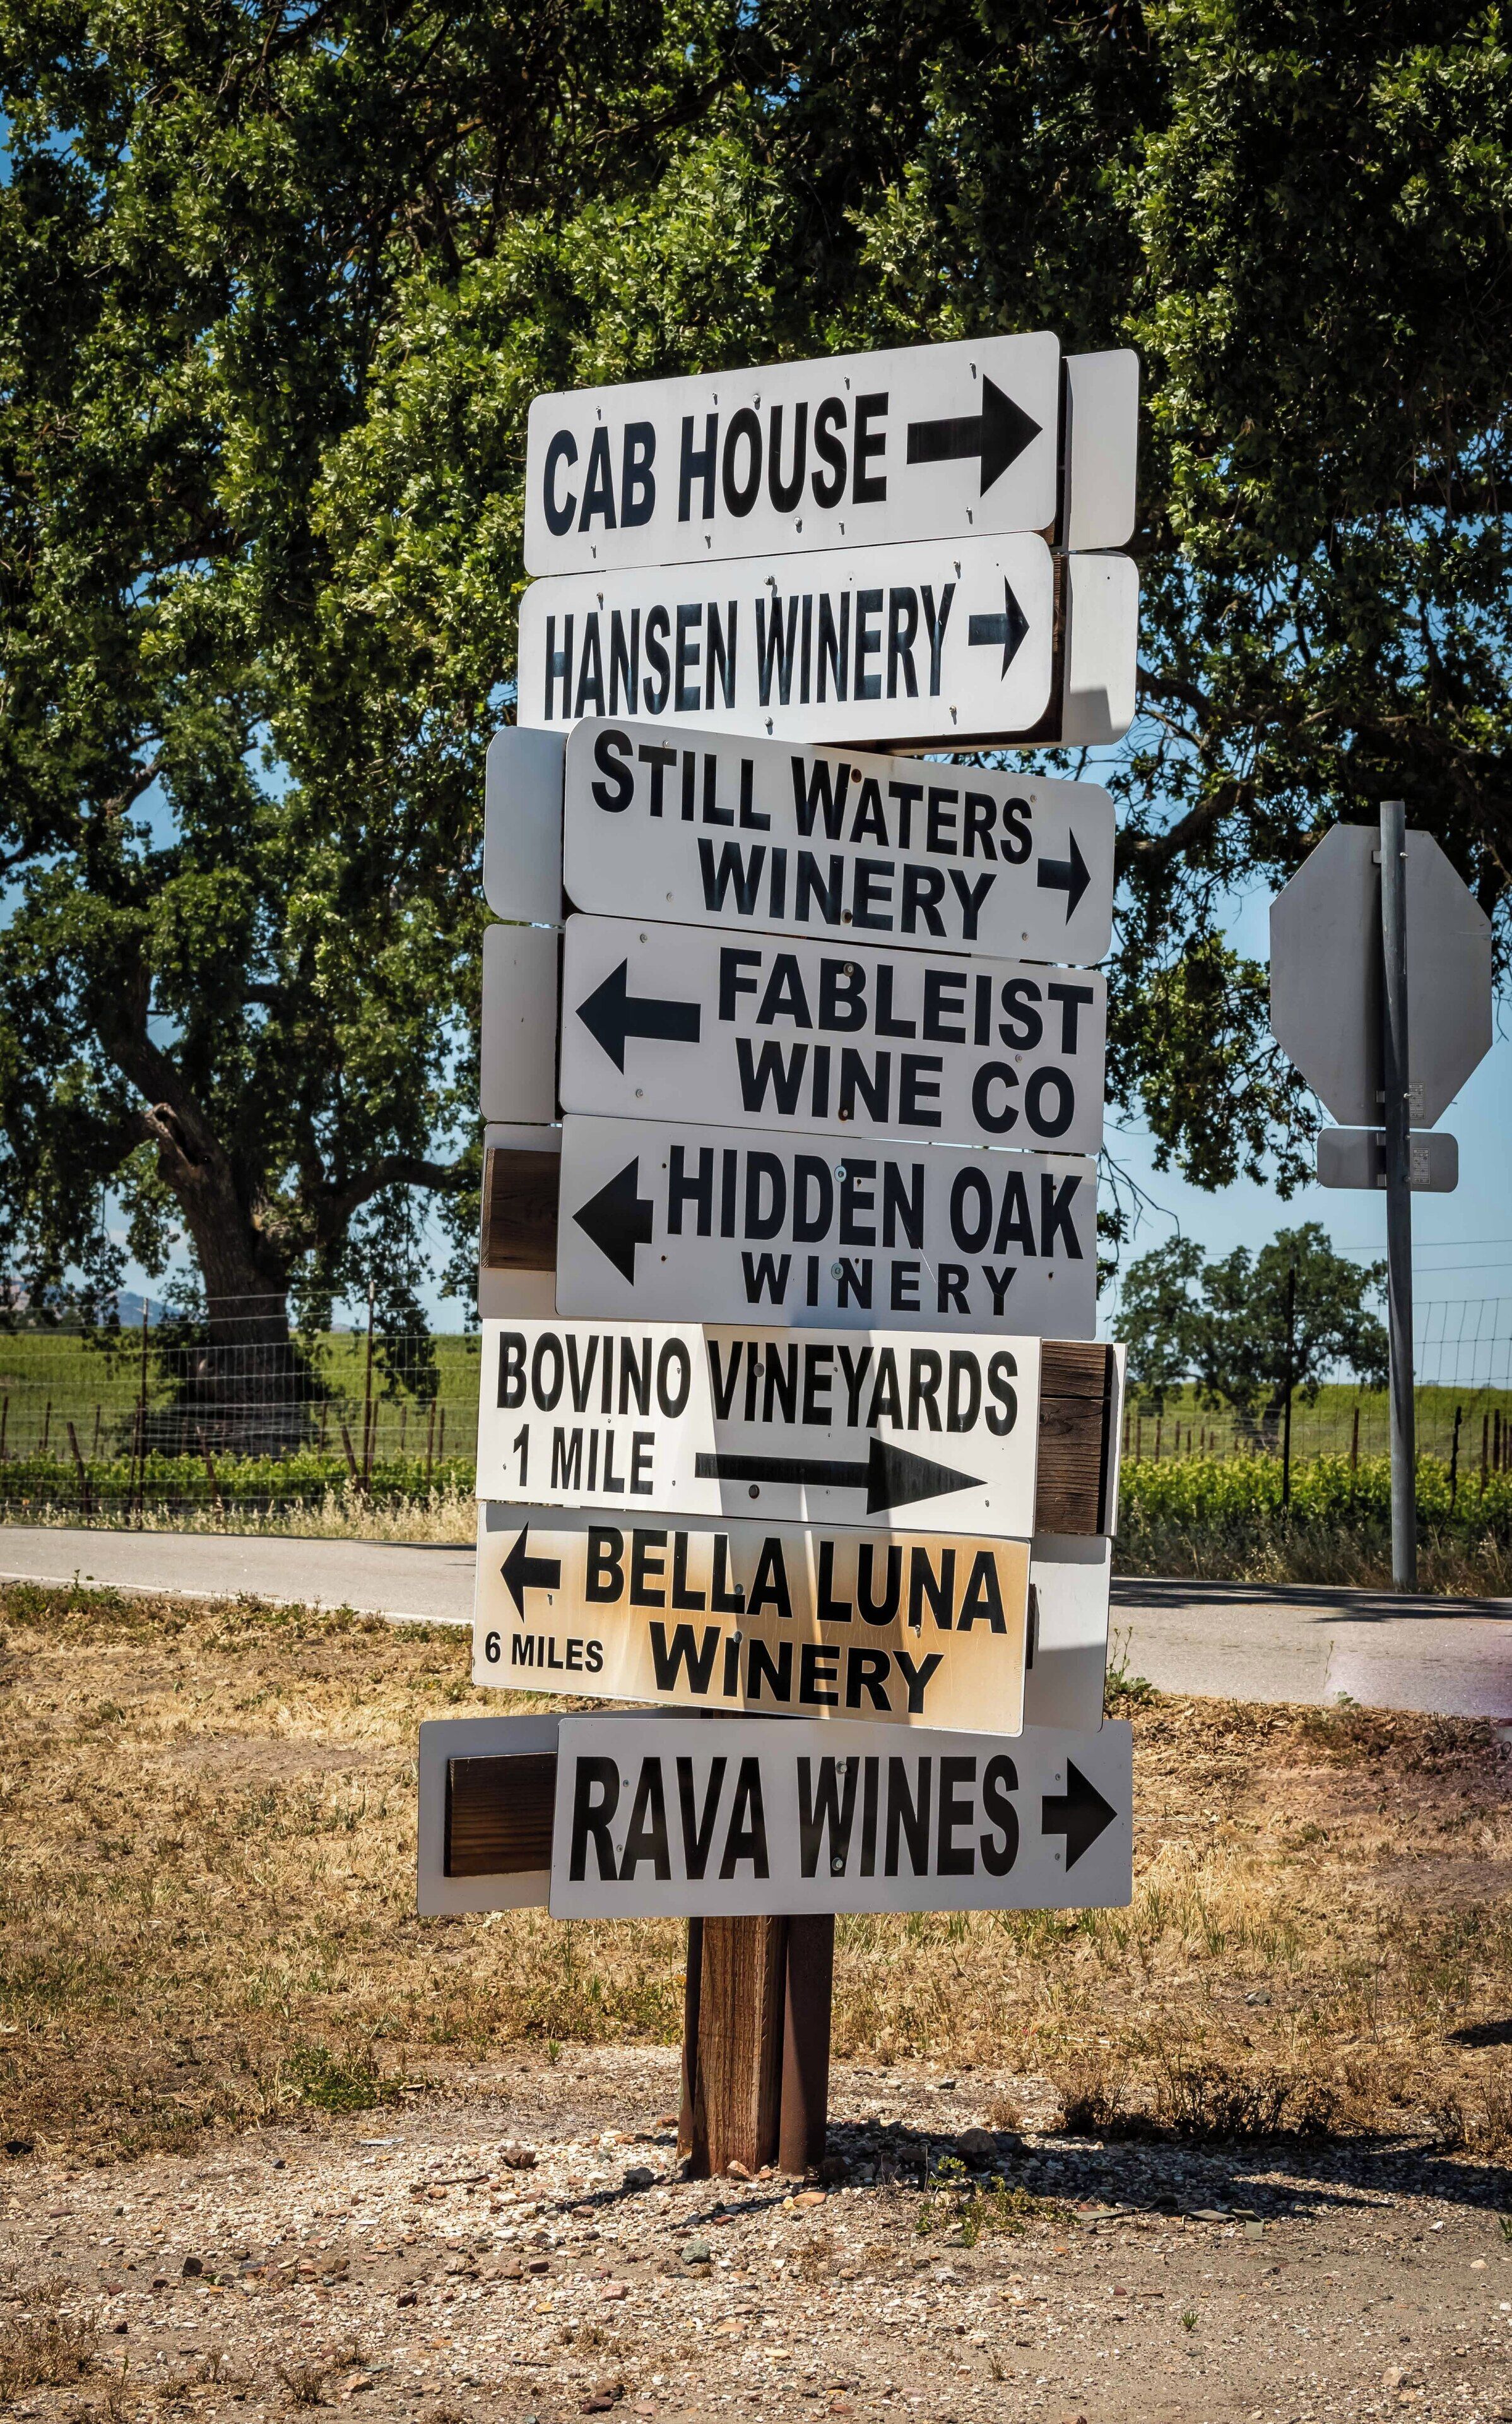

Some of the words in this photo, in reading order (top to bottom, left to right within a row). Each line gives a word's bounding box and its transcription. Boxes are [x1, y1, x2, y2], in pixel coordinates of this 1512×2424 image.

[543, 422, 656, 537] CAB
[678, 392, 889, 522] HOUSE
[545, 600, 737, 720] HANSEN
[755, 583, 956, 706] WINERY
[592, 730, 771, 831] STILL
[791, 756, 1032, 864] WATERS
[697, 838, 997, 940] WINERY
[719, 948, 1094, 1055] FABLEIST
[736, 1038, 943, 1127] WINE
[972, 1061, 1074, 1138] CO
[668, 1145, 924, 1249] HIDDEN
[950, 1167, 1083, 1259] OAK
[741, 1252, 1017, 1316] WINERY
[497, 1332, 690, 1418] BOVINO
[707, 1340, 1017, 1436] VINEYARDS
[513, 1424, 529, 1487] 1
[551, 1427, 654, 1495] MILE
[586, 1526, 792, 1618] BELLA
[817, 1541, 1007, 1634] LUNA
[485, 1632, 500, 1663] 6
[512, 1634, 603, 1672] MILES
[649, 1622, 944, 1713] WINERY
[569, 1757, 769, 1881] RAVA
[797, 1755, 1019, 1878] WINES
